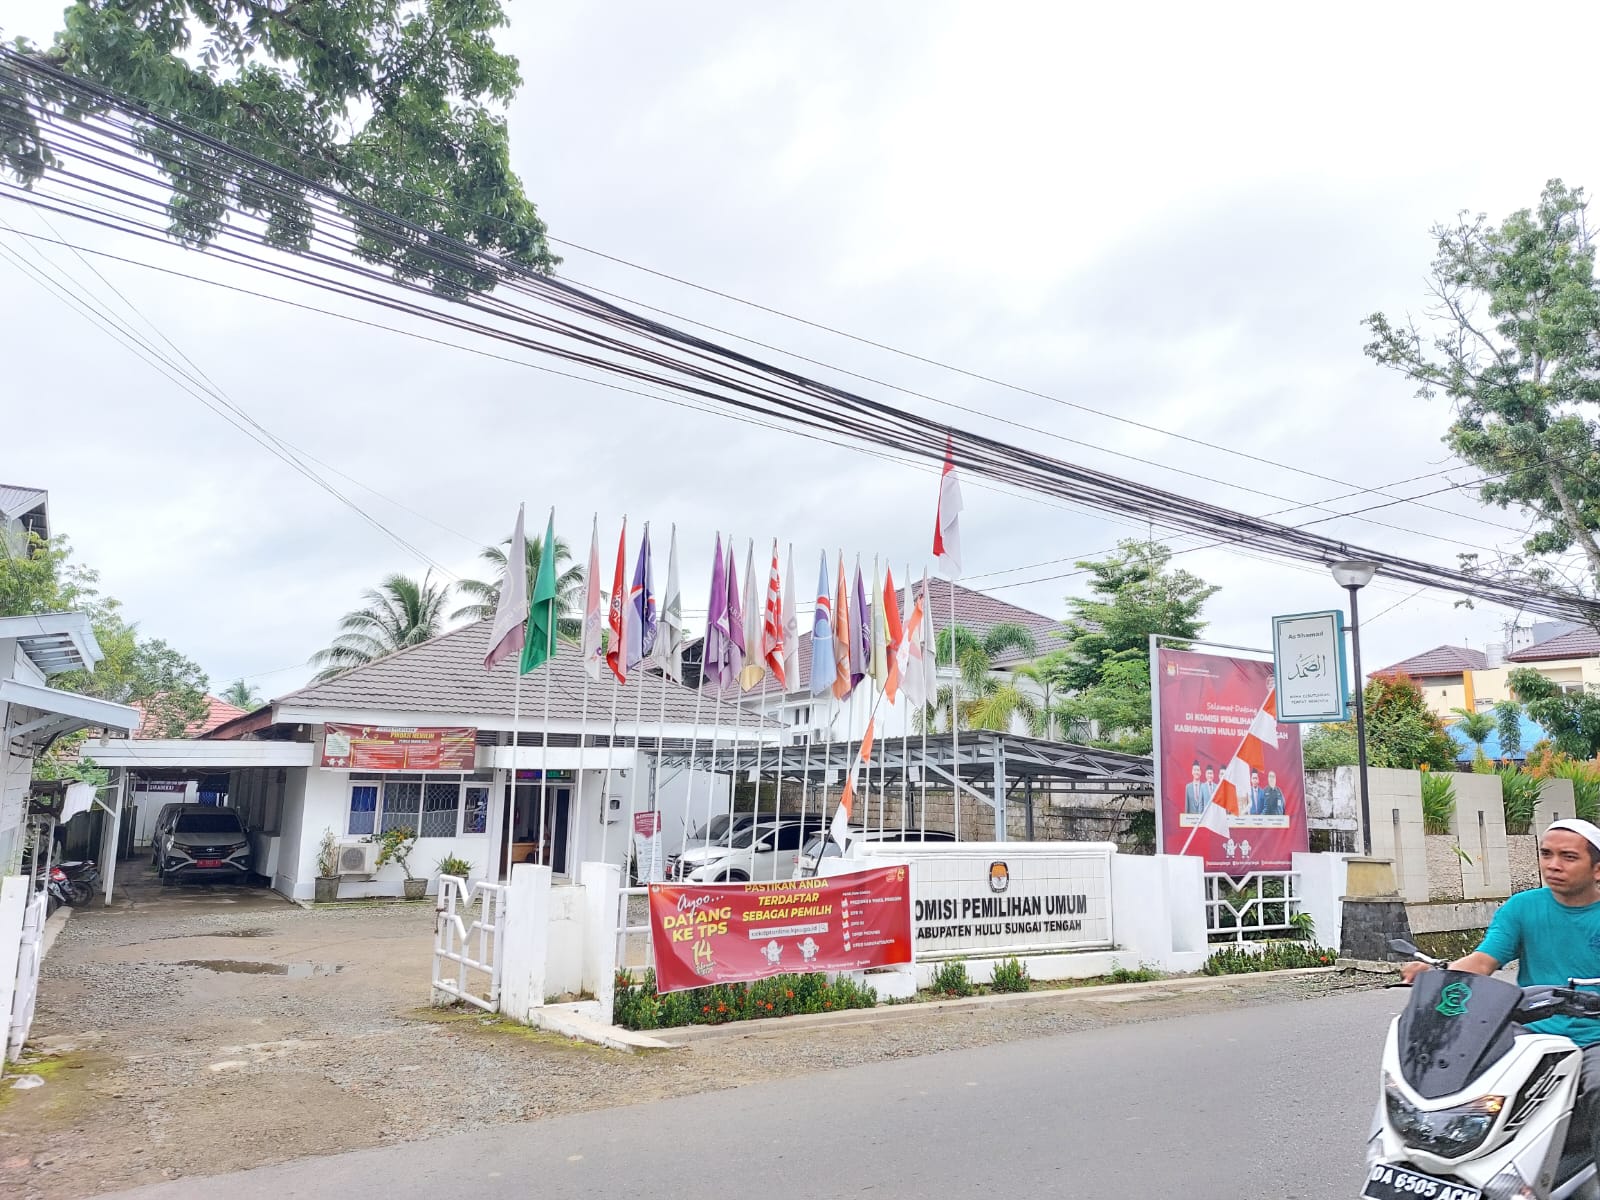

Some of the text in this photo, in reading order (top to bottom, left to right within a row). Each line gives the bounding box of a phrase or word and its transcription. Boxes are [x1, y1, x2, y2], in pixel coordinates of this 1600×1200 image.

[745, 879, 829, 893] PASTIKAN ANDA
[758, 893, 820, 906] TERDAFTAR
[915, 899, 958, 921] OMISI
[962, 896, 1041, 919] PEMILIHAN
[1045, 894, 1087, 915] UMUM
[663, 906, 732, 930] DATANG
[742, 905, 833, 922] SEBAGAI PEMILIH
[672, 921, 728, 943] KE TPS
[915, 919, 1082, 939] ABUPATEN HULU SUNGAI TENGAH
[691, 939, 714, 965] 14
[1371, 1166, 1394, 1185] DA
[1394, 1173, 1439, 1197] 6505
